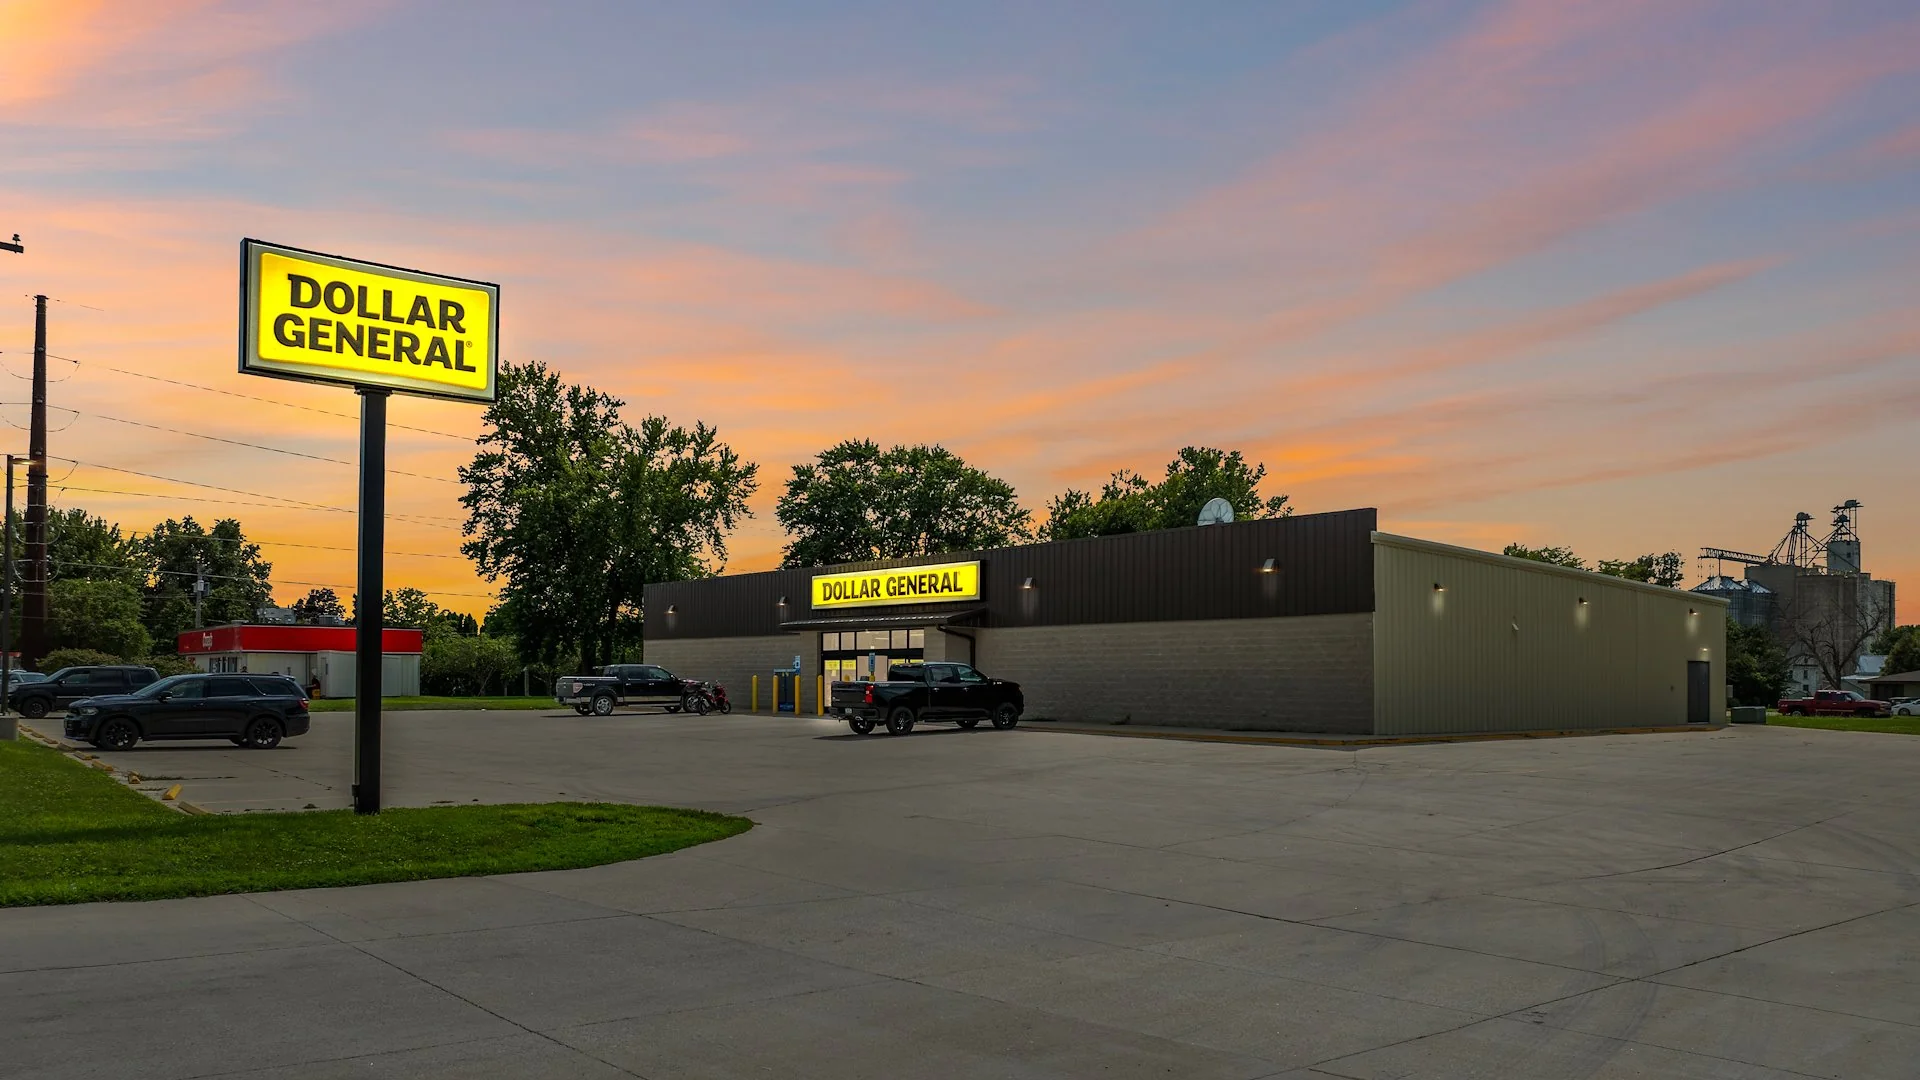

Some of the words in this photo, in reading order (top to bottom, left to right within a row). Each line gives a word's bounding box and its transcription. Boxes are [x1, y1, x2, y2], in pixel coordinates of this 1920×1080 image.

[287, 273, 466, 334] DOLLAR
[273, 313, 476, 373] GENERAL
[822, 578, 881, 601] DOLLAR
[886, 571, 963, 597] GENERAL
